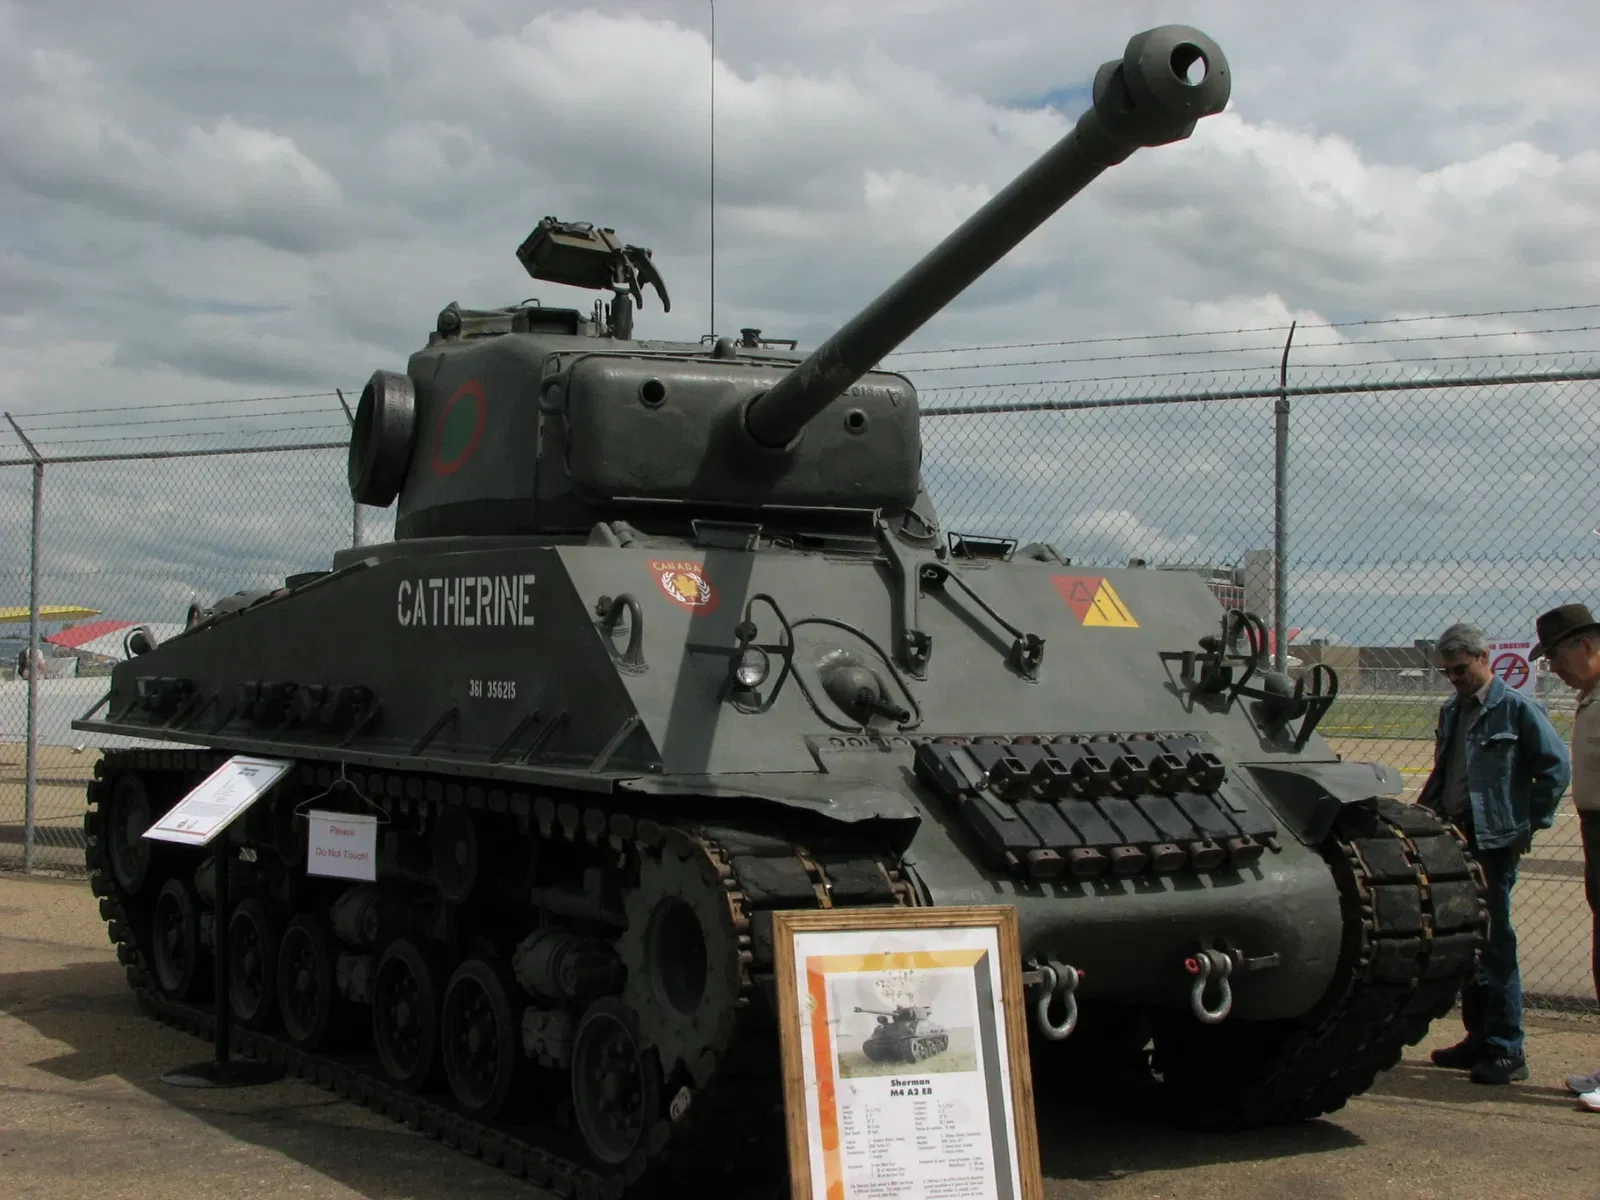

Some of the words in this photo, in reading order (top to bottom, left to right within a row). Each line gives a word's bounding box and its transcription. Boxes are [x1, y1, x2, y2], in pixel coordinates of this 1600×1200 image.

[652, 561, 702, 573] CANADA
[397, 574, 536, 627] CATHERINE
[1499, 642, 1530, 650] SMOKING
[469, 679, 482, 698] 361
[487, 680, 516, 699] 356215
[329, 825, 356, 837] Please
[315, 847, 327, 857] Do
[328, 848, 342, 859] Not
[343, 850, 369, 862] Touch!
[890, 1078, 931, 1087] Sherman
[890, 1088, 904, 1097] M4
[907, 1087, 919, 1096] A2
[922, 1086, 933, 1095] E8
